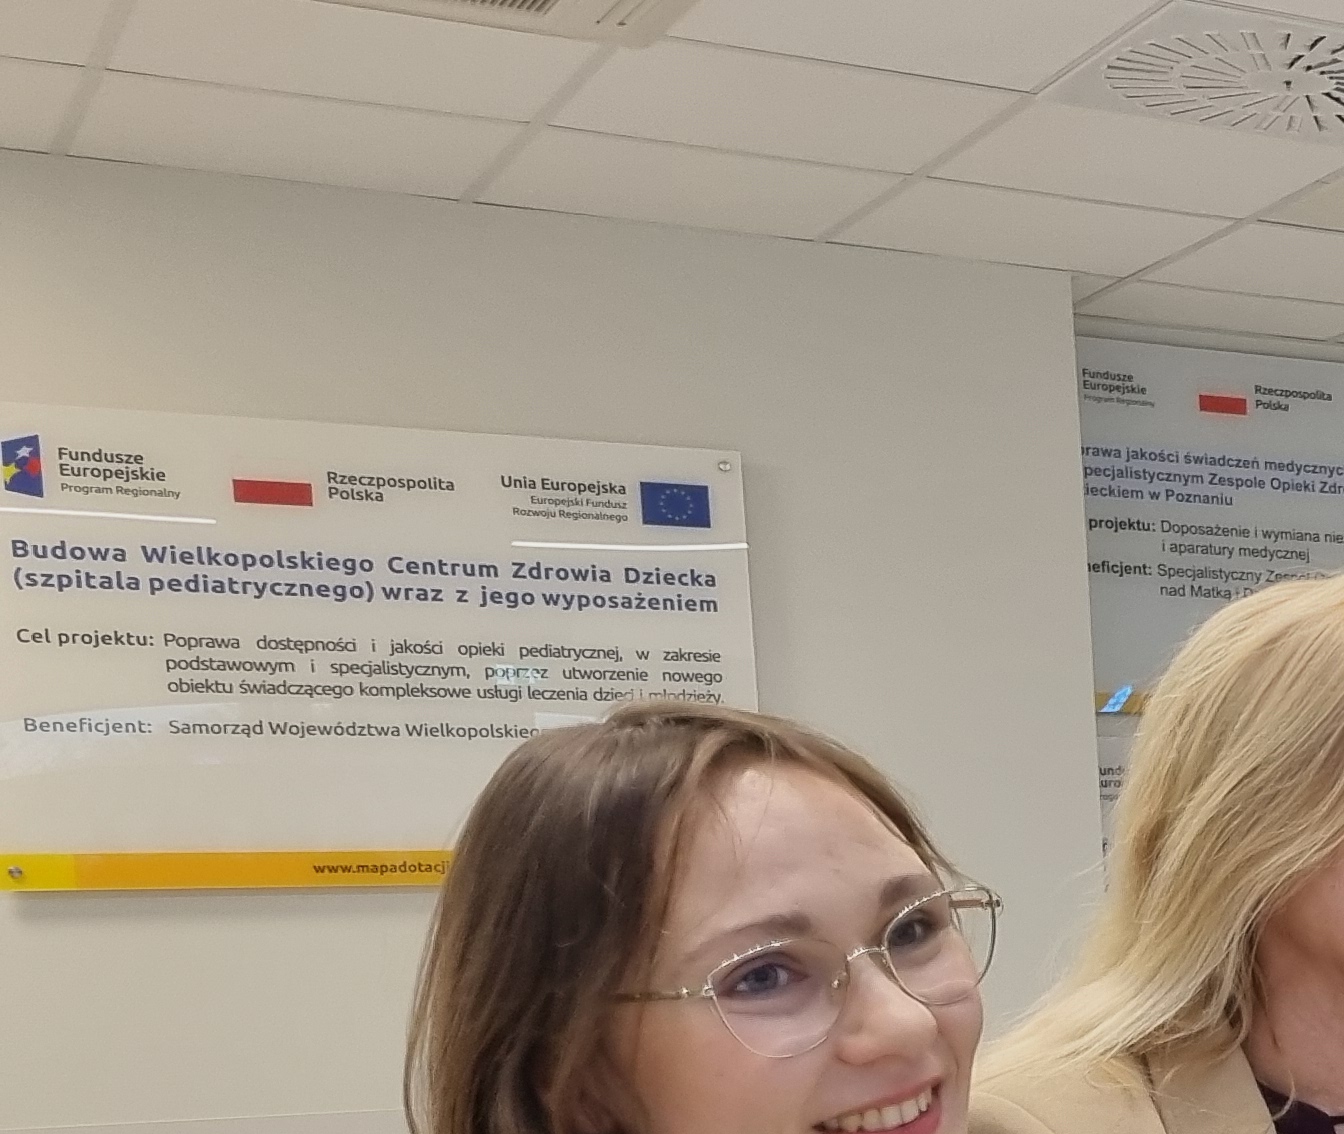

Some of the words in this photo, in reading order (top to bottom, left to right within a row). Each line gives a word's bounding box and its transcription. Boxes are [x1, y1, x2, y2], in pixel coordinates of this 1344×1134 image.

[1082, 368, 1134, 383] Fundusze
[1083, 380, 1147, 395] Europejskie
[1254, 385, 1333, 402] Rzeczpospolita
[1255, 400, 1290, 412] Polska
[58, 447, 144, 465] Fundusze
[1126, 446, 1179, 463] jakości
[1184, 452, 1260, 470] świadczeń
[59, 463, 166, 482] Europejskie
[327, 471, 455, 492] Rzeczpospolita
[1084, 465, 1204, 486] pecjalistycznym
[1208, 473, 1266, 490] Zespole
[1270, 477, 1316, 493] Opieki
[61, 483, 113, 496] Program
[116, 486, 181, 499] Regionalny
[328, 487, 384, 502] Polska
[500, 475, 536, 490] Unia
[541, 478, 627, 496] Europejska
[1084, 484, 1144, 500] ieckiem
[1149, 490, 1160, 500] w
[1165, 489, 1233, 506] Poznaniu
[531, 495, 583, 507] Europejski
[586, 499, 628, 509] Fundusz
[512, 507, 556, 520] Rozwoju
[559, 511, 628, 523] Regionalnego
[1089, 517, 1156, 533] projektu:
[1160, 520, 1251, 539] Doposażenie
[1261, 529, 1320, 544] wymiana
[1169, 542, 1235, 558] aparatury
[1238, 547, 1311, 563] medycznej
[11, 539, 127, 562] Budowa
[141, 545, 375, 577] Wielkopolskiego
[387, 556, 499, 578] Centrum
[511, 561, 612, 584] Zdrowia
[624, 567, 717, 588] Dziecka
[1157, 563, 1262, 584] Specjalistyczny
[13, 567, 141, 592] (szpitala
[149, 573, 375, 602] pediatrycznego)
[382, 585, 443, 602] wraz
[456, 588, 469, 602] z
[480, 585, 535, 611] jego
[541, 591, 719, 613] wyposażeniem
[1160, 585, 1186, 597] nad
[1190, 586, 1232, 601] Matką
[17, 628, 52, 644] Cel
[58, 630, 155, 648] projektu:
[163, 632, 241, 651] Poprawa
[256, 635, 357, 653] dostępności
[389, 639, 443, 656] jakości
[458, 641, 506, 658] opieki
[519, 644, 624, 663] pediatrycznej,
[636, 649, 650, 661] w
[662, 649, 721, 664] zakresie
[166, 656, 295, 676] podstawowym
[330, 660, 471, 680] specjalistycznym,
[484, 666, 549, 682] poprzez
[562, 666, 649, 682] utworzenie
[662, 670, 723, 686] nowego
[167, 677, 233, 694] obiektu
[239, 678, 354, 698] świadczącego
[359, 683, 472, 700] kompleksowe
[477, 685, 523, 703] usługi
[527, 685, 588, 702] leczenia
[24, 717, 153, 736] Beneficjent:
[169, 719, 264, 738] Samorząd
[268, 720, 400, 740] Województwa
